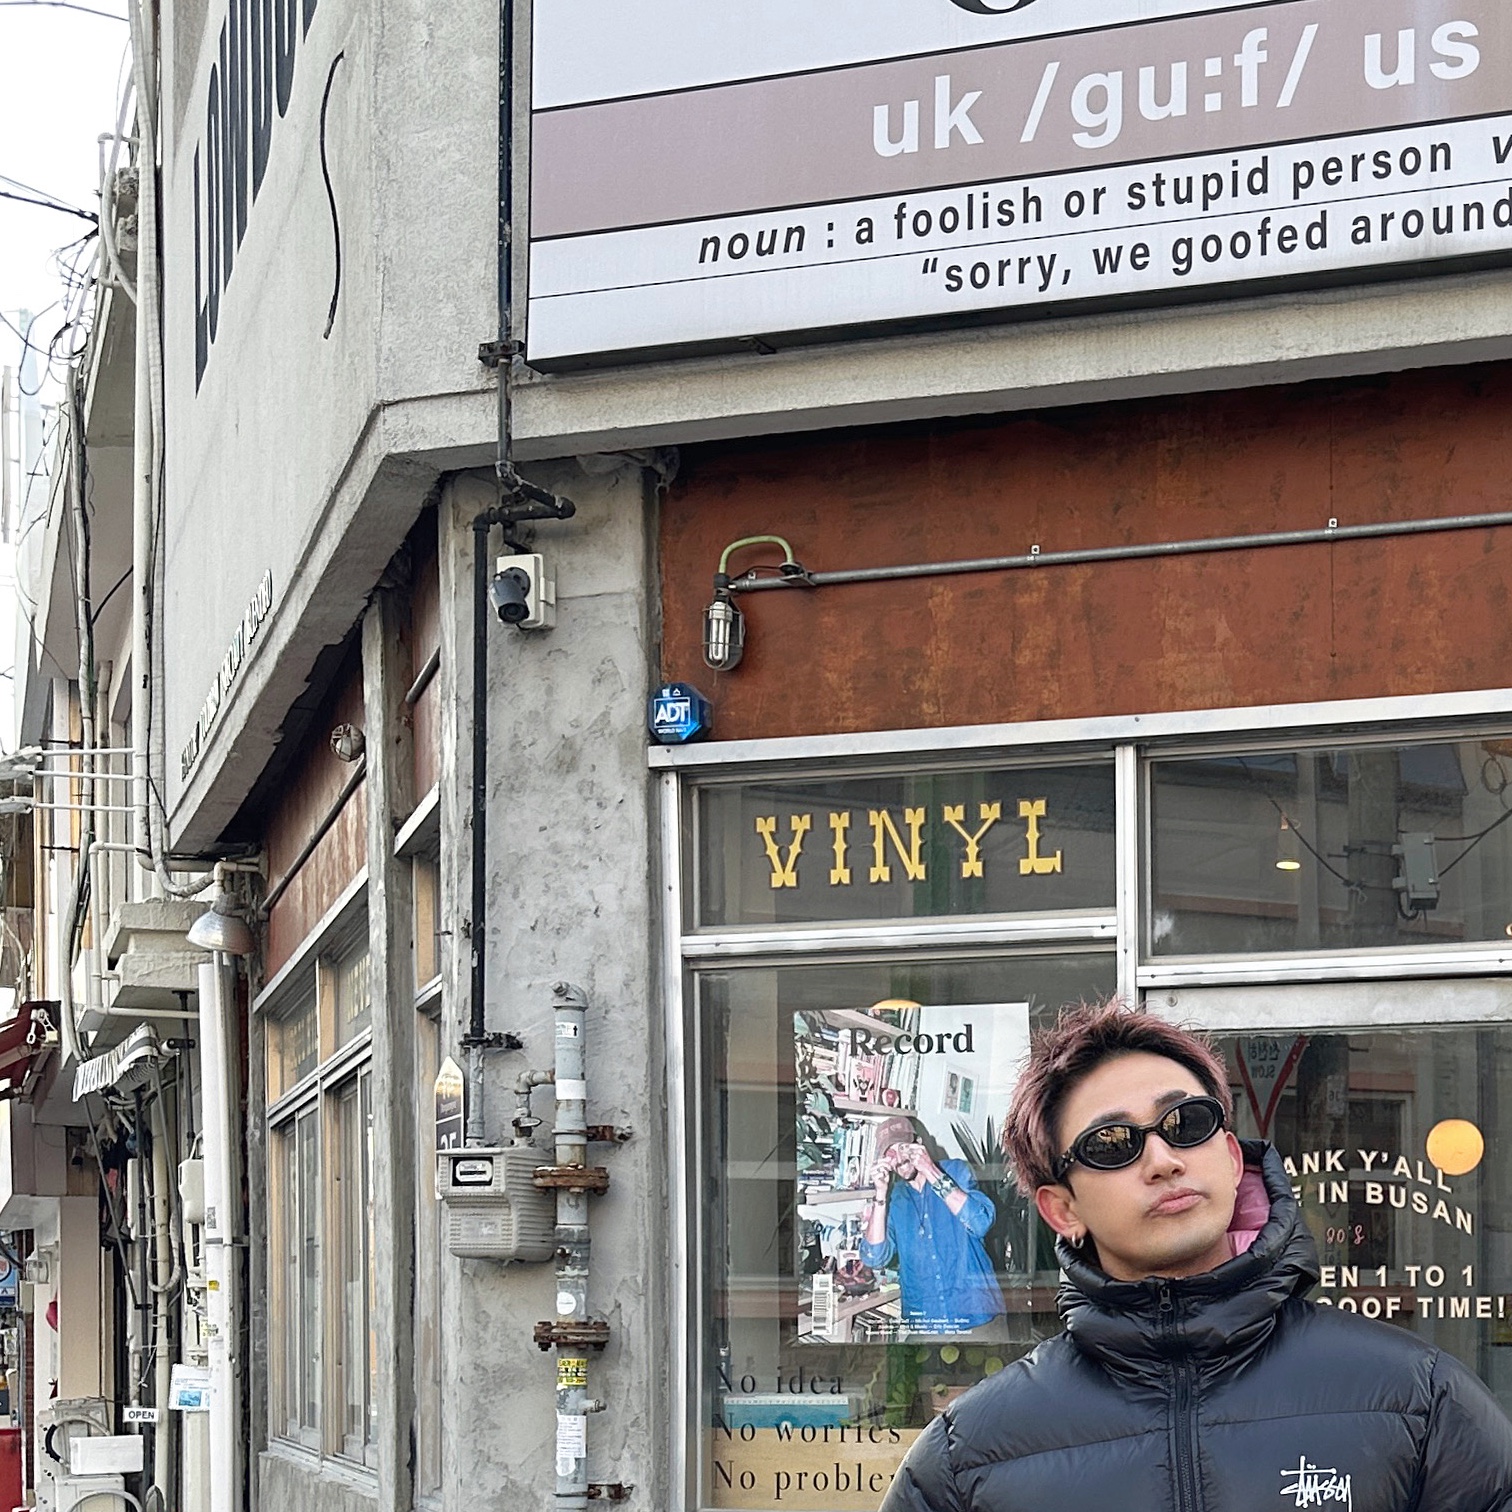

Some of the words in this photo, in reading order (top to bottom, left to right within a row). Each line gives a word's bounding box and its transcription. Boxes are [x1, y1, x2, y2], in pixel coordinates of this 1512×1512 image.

[872, 74, 985, 158] uk
[1019, 23, 1319, 149] /gu:f/
[1363, 18, 1482, 90] us
[698, 224, 806, 265] noun
[826, 221, 834, 249] :
[855, 217, 874, 244] a
[895, 186, 1043, 241] foolish
[1065, 185, 1107, 218] or
[1127, 155, 1270, 213] stupid
[1291, 133, 1453, 200] person
[1093, 240, 1151, 276] we
[1172, 211, 1328, 278] goofed
[654, 701, 690, 723] ADT
[755, 797, 1063, 889] VINYL
[847, 1023, 976, 1058] Record
[1318, 1180, 1349, 1204] IN
[1365, 1181, 1474, 1236] BUSAN
[1375, 1265, 1387, 1288] 1
[1405, 1265, 1446, 1288] TO
[1461, 1265, 1474, 1287] 1
[1417, 1296, 1505, 1319] TIME!
[715, 1365, 756, 1395] No
[776, 1365, 843, 1395] idea
[128, 1410, 155, 1420] OPEN
[712, 1413, 756, 1443] No
[775, 1413, 901, 1445] worries
[712, 1460, 756, 1491] No
[773, 1462, 895, 1501] proble
